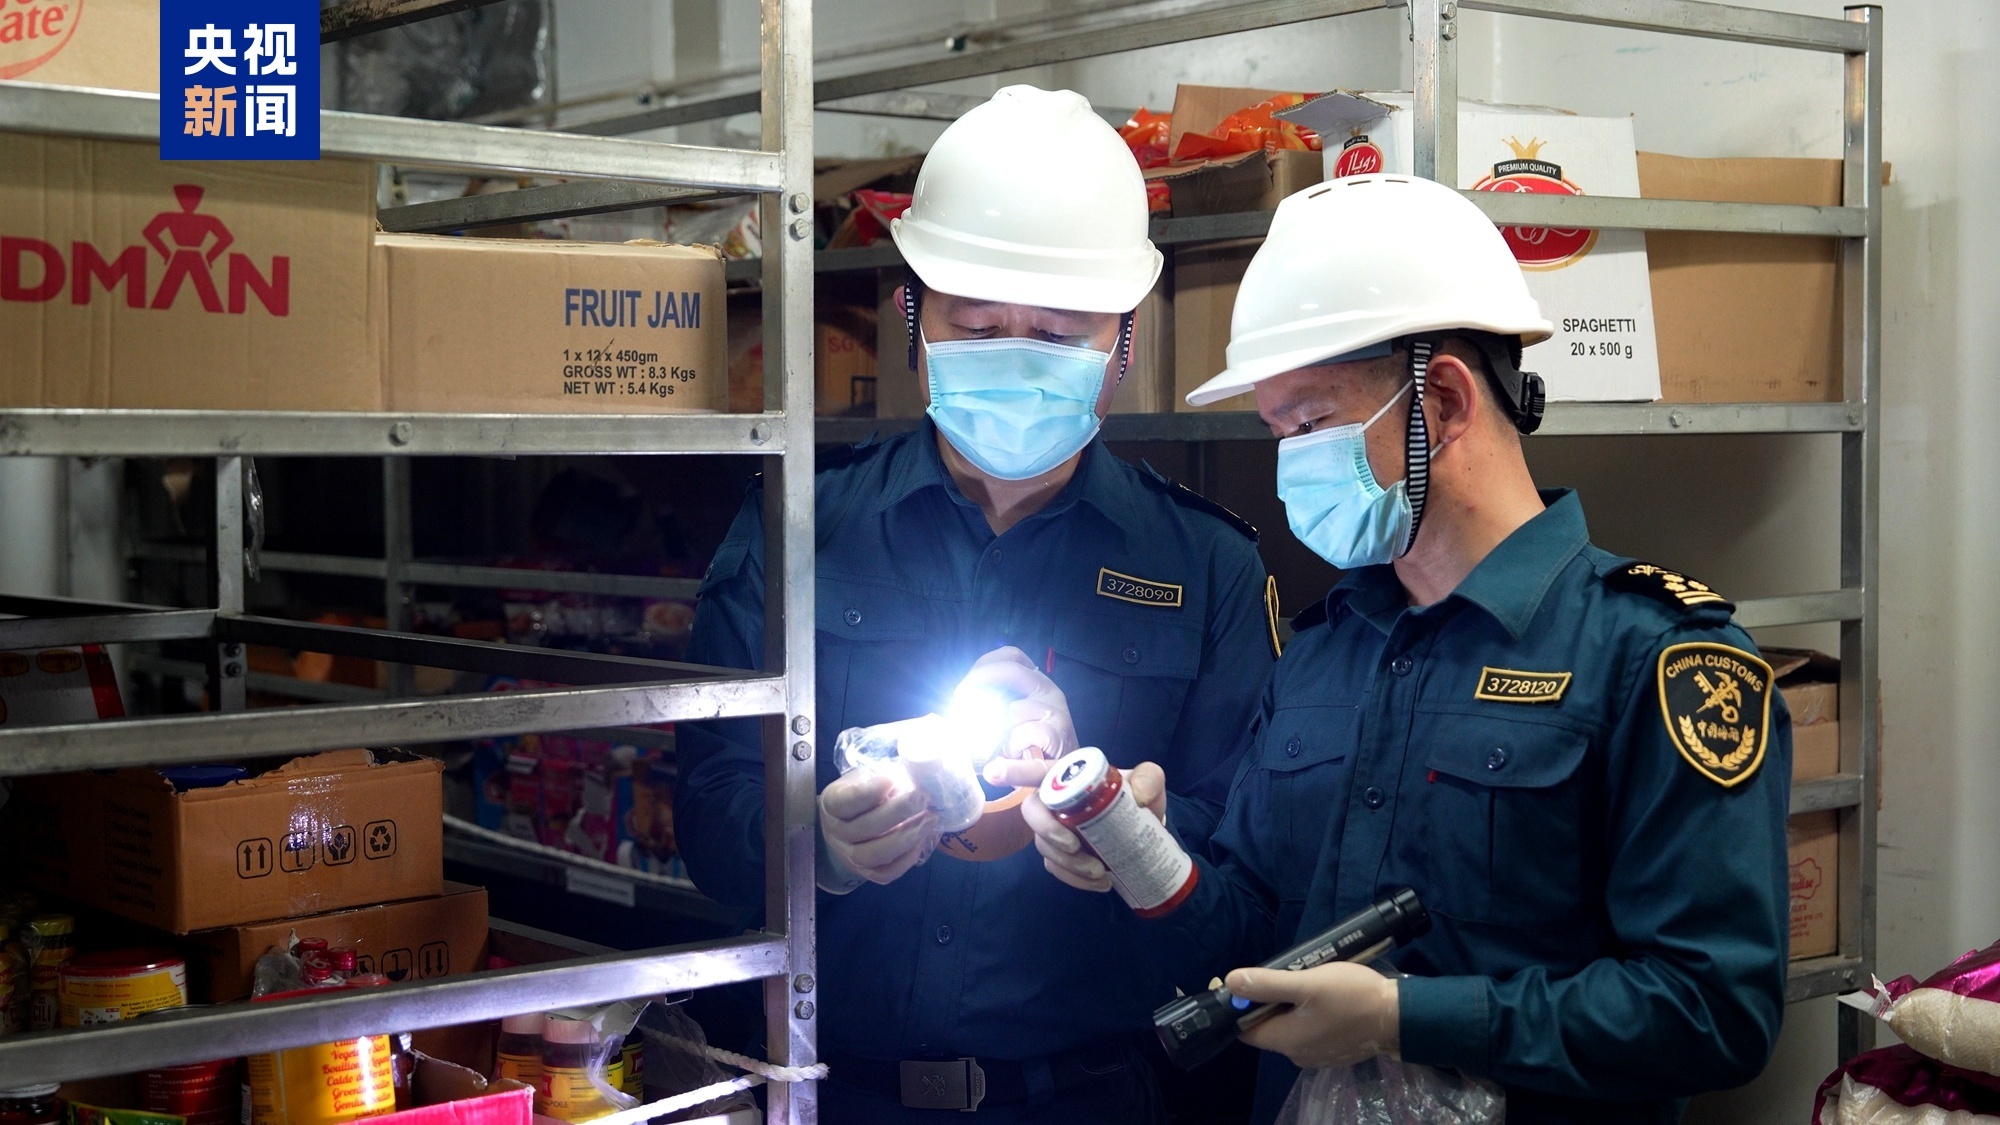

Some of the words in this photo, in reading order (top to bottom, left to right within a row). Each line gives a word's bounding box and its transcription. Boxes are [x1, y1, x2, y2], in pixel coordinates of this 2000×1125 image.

[1498, 162, 1529, 173] PREMIUM
[1529, 163, 1557, 176] QUALITY
[565, 288, 642, 327] FRUIT
[647, 290, 701, 329] JAM
[1562, 318, 1636, 332] SPAGHETTI
[563, 349, 570, 361] 1
[574, 351, 582, 362] x
[586, 349, 600, 362] 12
[605, 351, 613, 362] x
[616, 350, 658, 365] 450gm
[1570, 342, 1585, 356] 20
[1589, 344, 1597, 356] x
[1600, 342, 1621, 356] 500
[1625, 345, 1633, 359] g
[563, 365, 613, 379] GROSS
[616, 366, 637, 378] WT
[648, 366, 667, 379] 8.3
[671, 366, 697, 382] Kgs
[563, 381, 590, 395] NET
[595, 381, 616, 395] WT
[627, 381, 646, 395] 5.4
[650, 381, 675, 398] Kgs
[1106, 578, 1175, 601] 3728090
[1665, 654, 1704, 679] CHINA
[1704, 653, 1764, 693] CUSTOMS
[1486, 678, 1557, 695] 3728120
